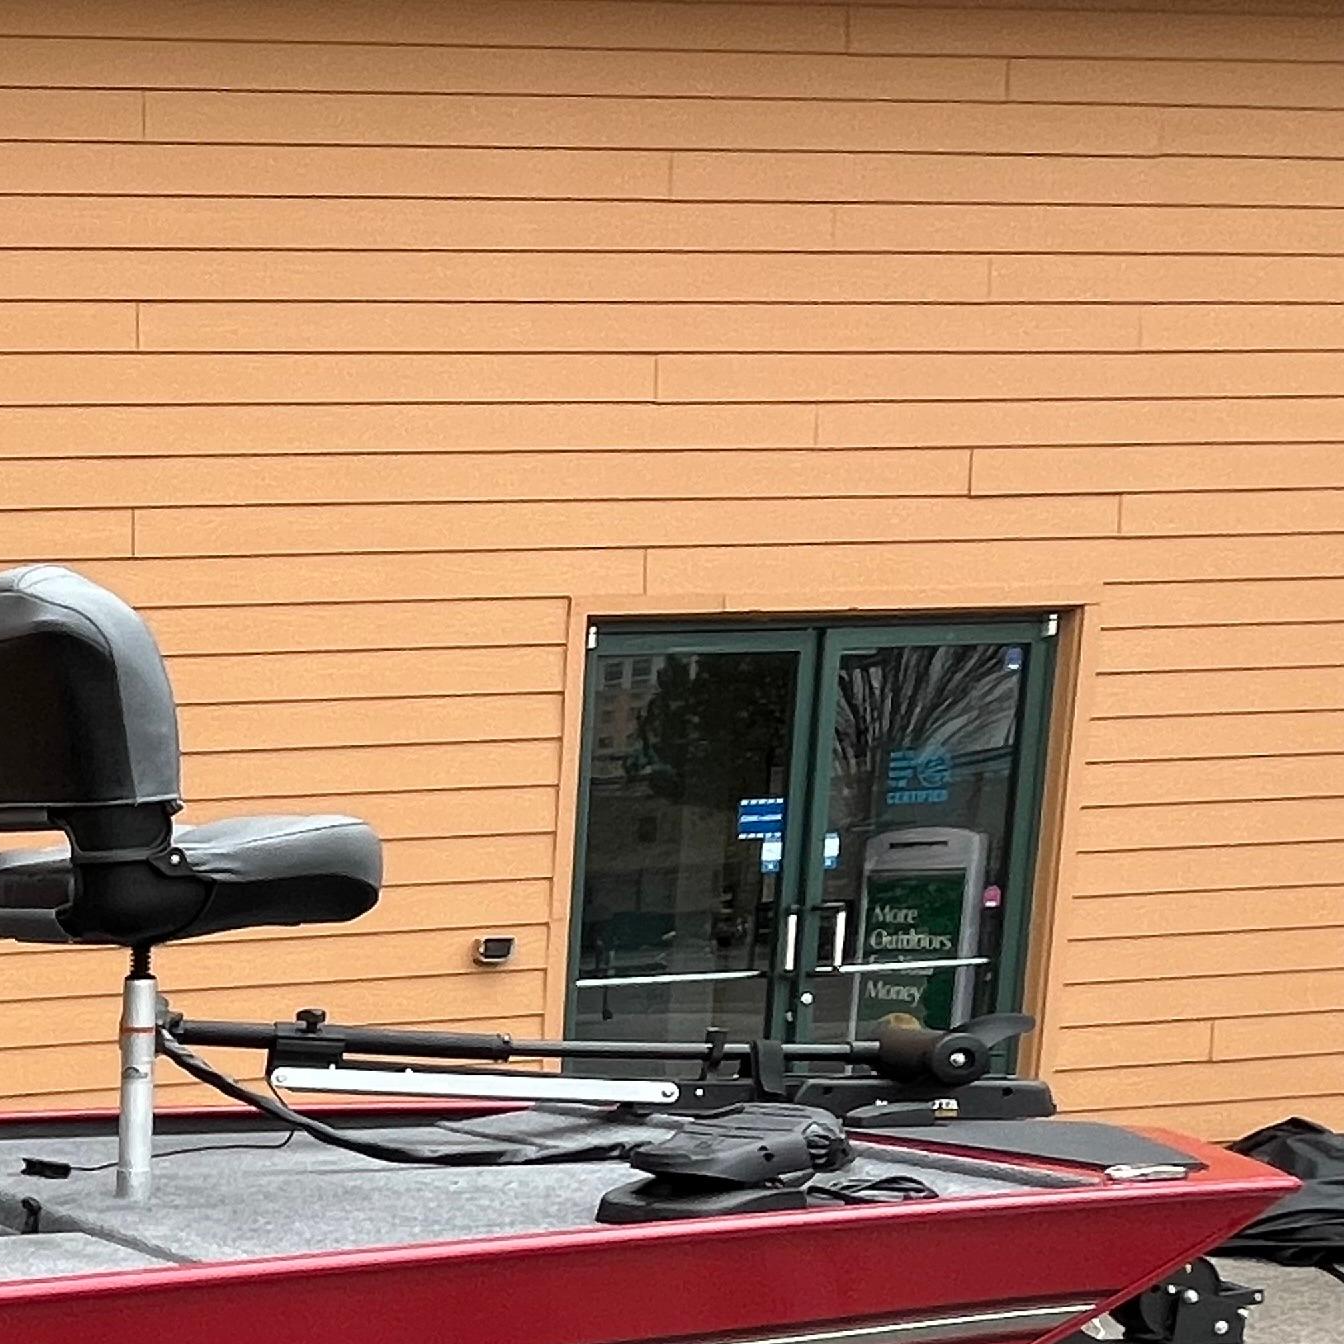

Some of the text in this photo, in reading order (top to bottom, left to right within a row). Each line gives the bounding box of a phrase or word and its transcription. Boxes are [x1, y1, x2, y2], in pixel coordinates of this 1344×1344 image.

[872, 904, 918, 924] More
[870, 928, 952, 950] Outdoors
[865, 980, 928, 1008] Money
